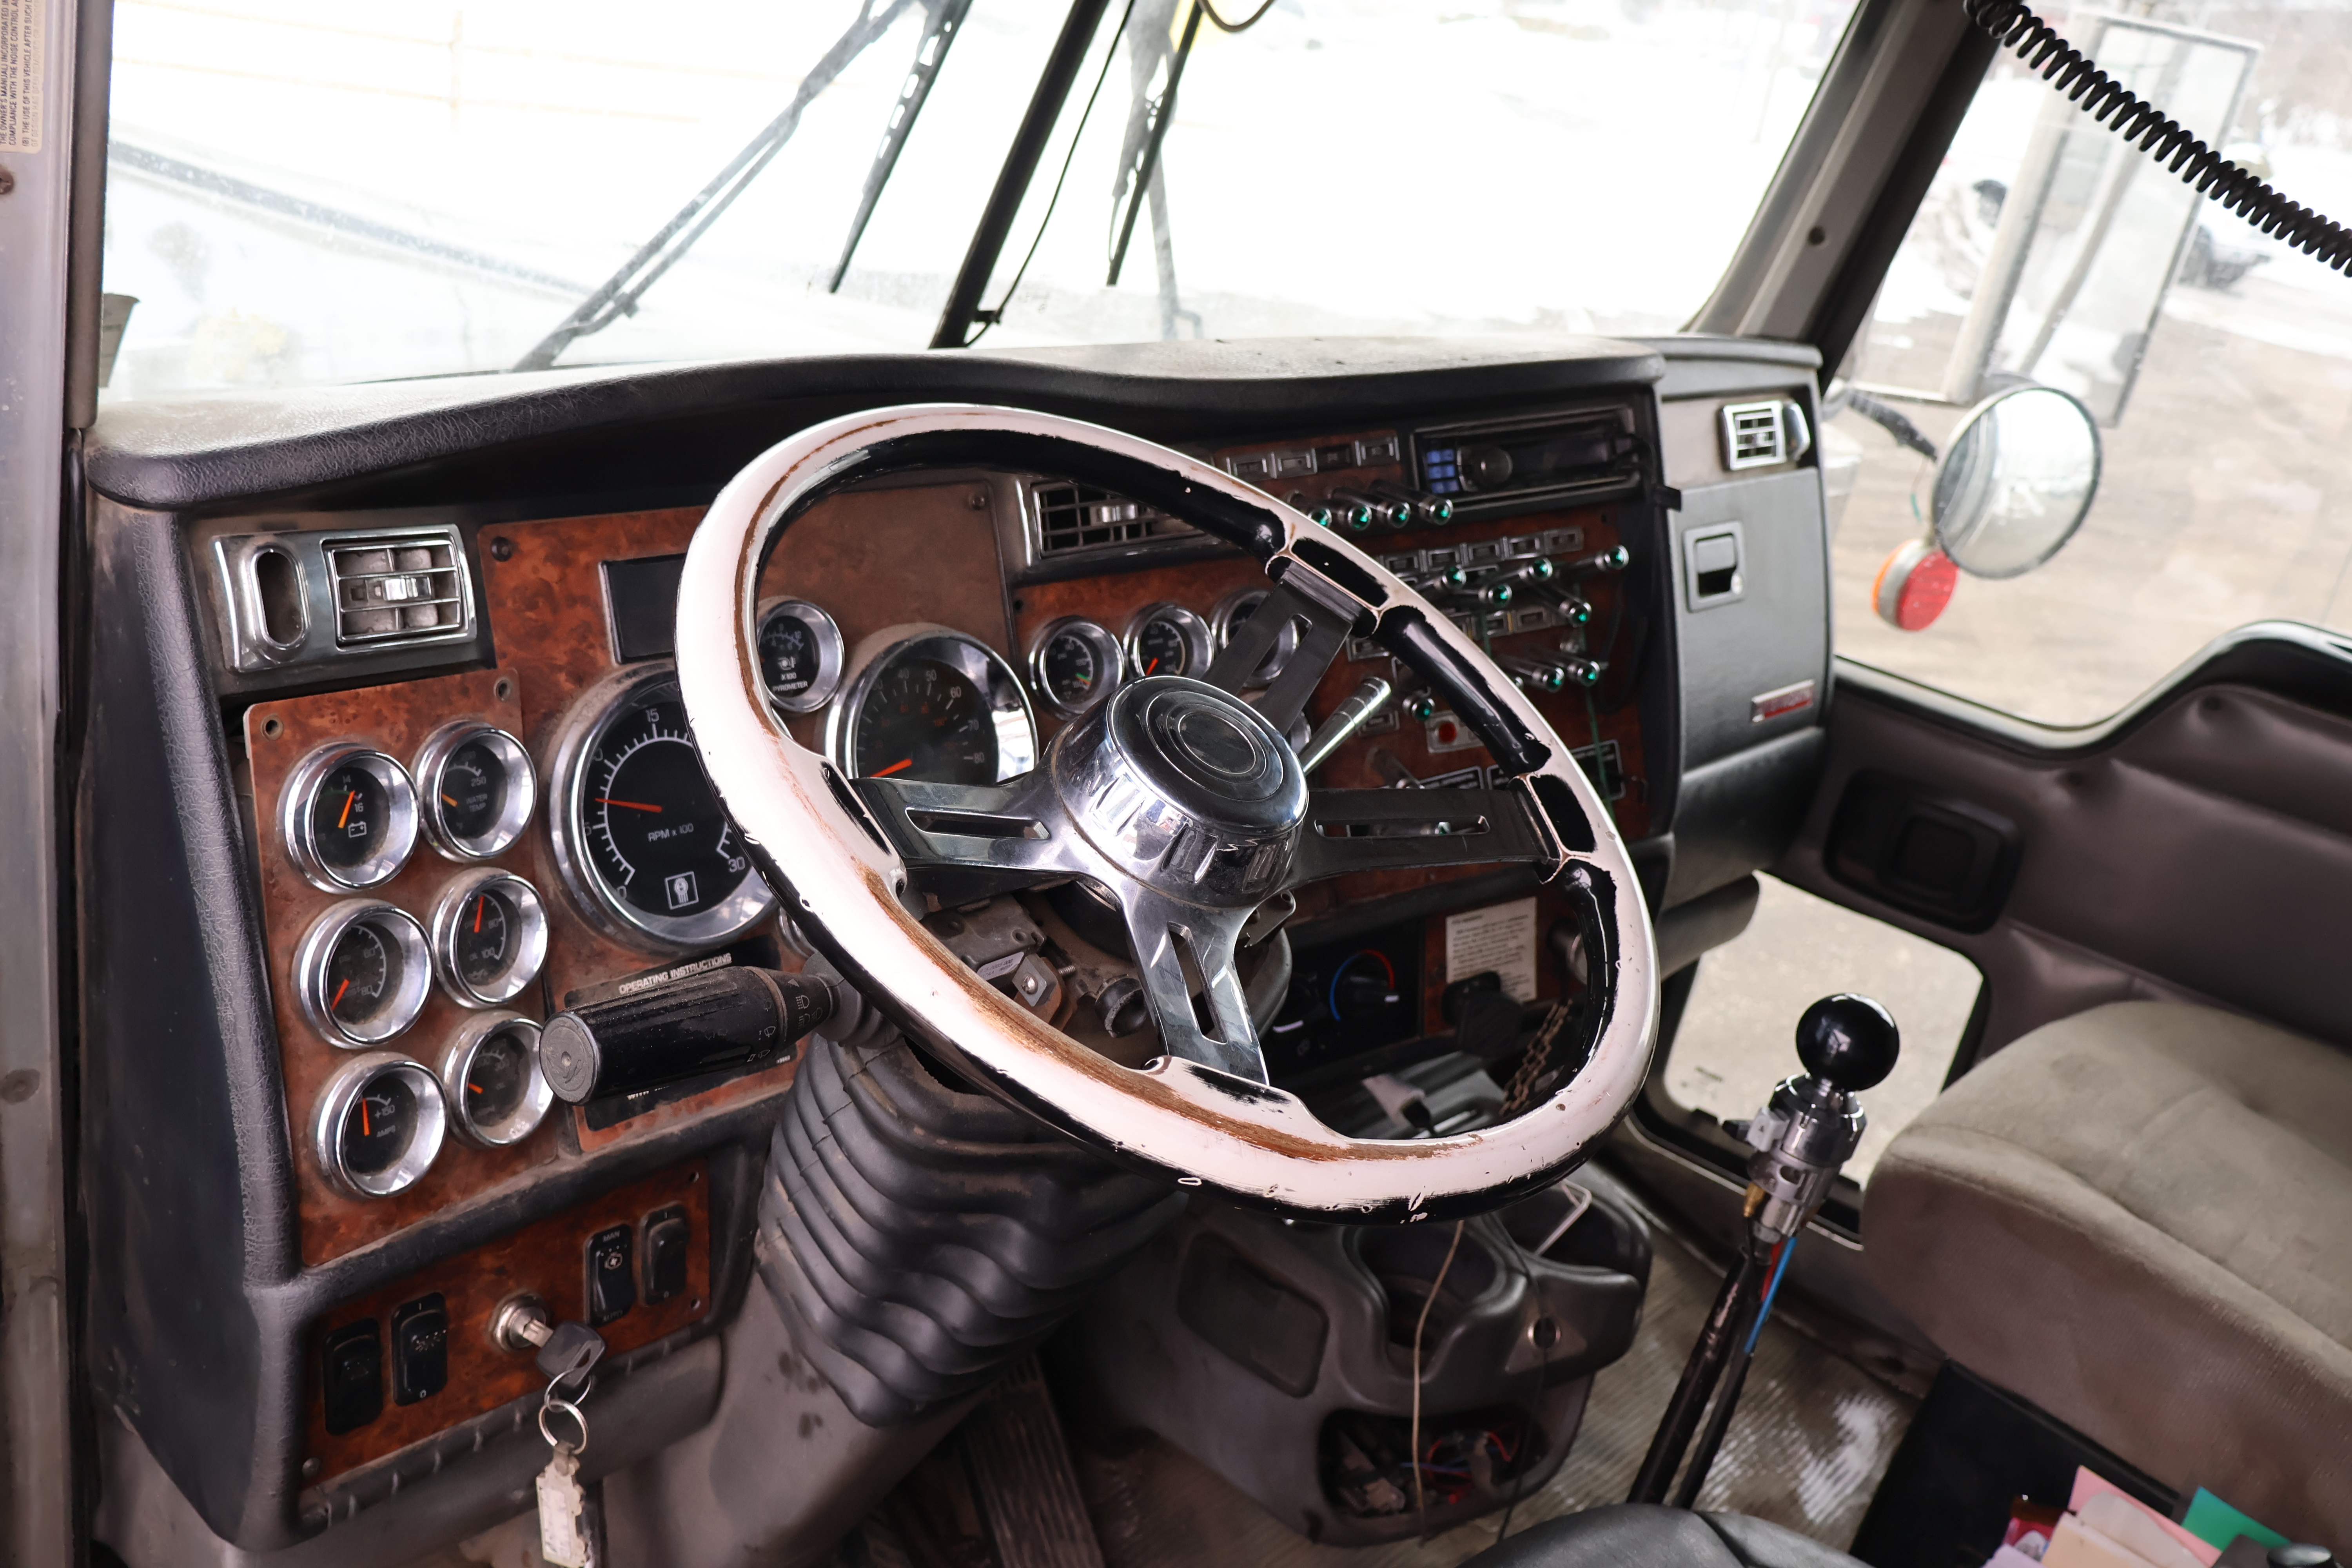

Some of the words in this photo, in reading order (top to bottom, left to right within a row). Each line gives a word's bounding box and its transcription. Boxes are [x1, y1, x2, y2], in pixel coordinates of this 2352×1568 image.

[24, 4, 32, 24] SUCH
[10, 9, 18, 41] CONTROL
[9, 66, 18, 78] THE
[22, 96, 30, 105] OF
[926, 669, 937, 681] 50
[772, 681, 808, 692] PYROMETER
[950, 686, 962, 698] 60
[646, 708, 659, 722] 15
[968, 719, 979, 731] 70
[974, 751, 985, 764] 80
[342, 775, 351, 784] 14
[471, 775, 486, 787] 250
[466, 793, 488, 804] WATER
[354, 802, 364, 813] 16
[469, 802, 486, 812] TEMP
[648, 828, 670, 842] RPM
[679, 822, 694, 834] 100
[727, 856, 745, 873] 30
[617, 885, 627, 900] 0
[619, 971, 669, 995] OPERATING
[669, 953, 732, 980] INSTRUCTIONS
[603, 1230, 620, 1243] MAN
